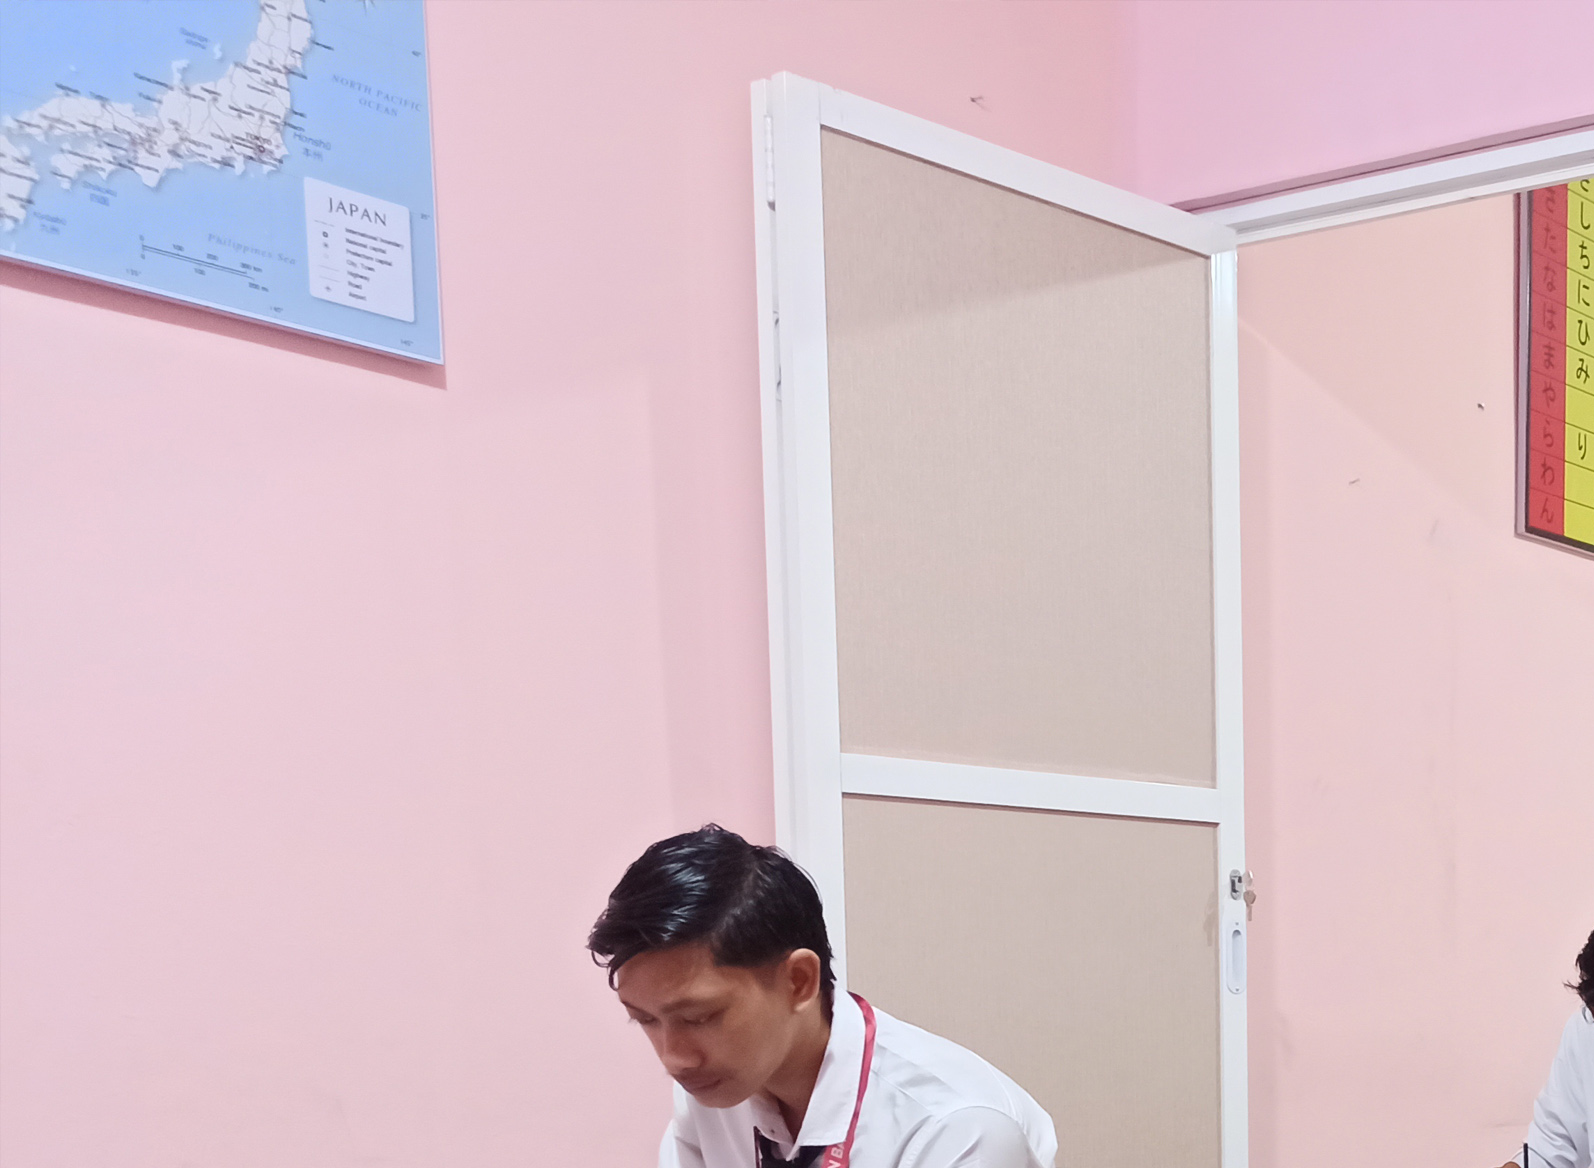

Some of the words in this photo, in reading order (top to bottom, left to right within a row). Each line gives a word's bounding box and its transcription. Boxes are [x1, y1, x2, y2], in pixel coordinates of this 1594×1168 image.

[332, 74, 372, 95] NORTH
[376, 89, 422, 112] PACIFIC
[359, 98, 398, 117] OCEAN
[328, 197, 387, 226] JAPAN
[1580, 201, 1590, 230] し
[1578, 240, 1590, 269] ち
[1577, 280, 1590, 307] に
[1577, 319, 1590, 346] ひ
[1576, 358, 1590, 385] み
[1577, 432, 1588, 460] り
